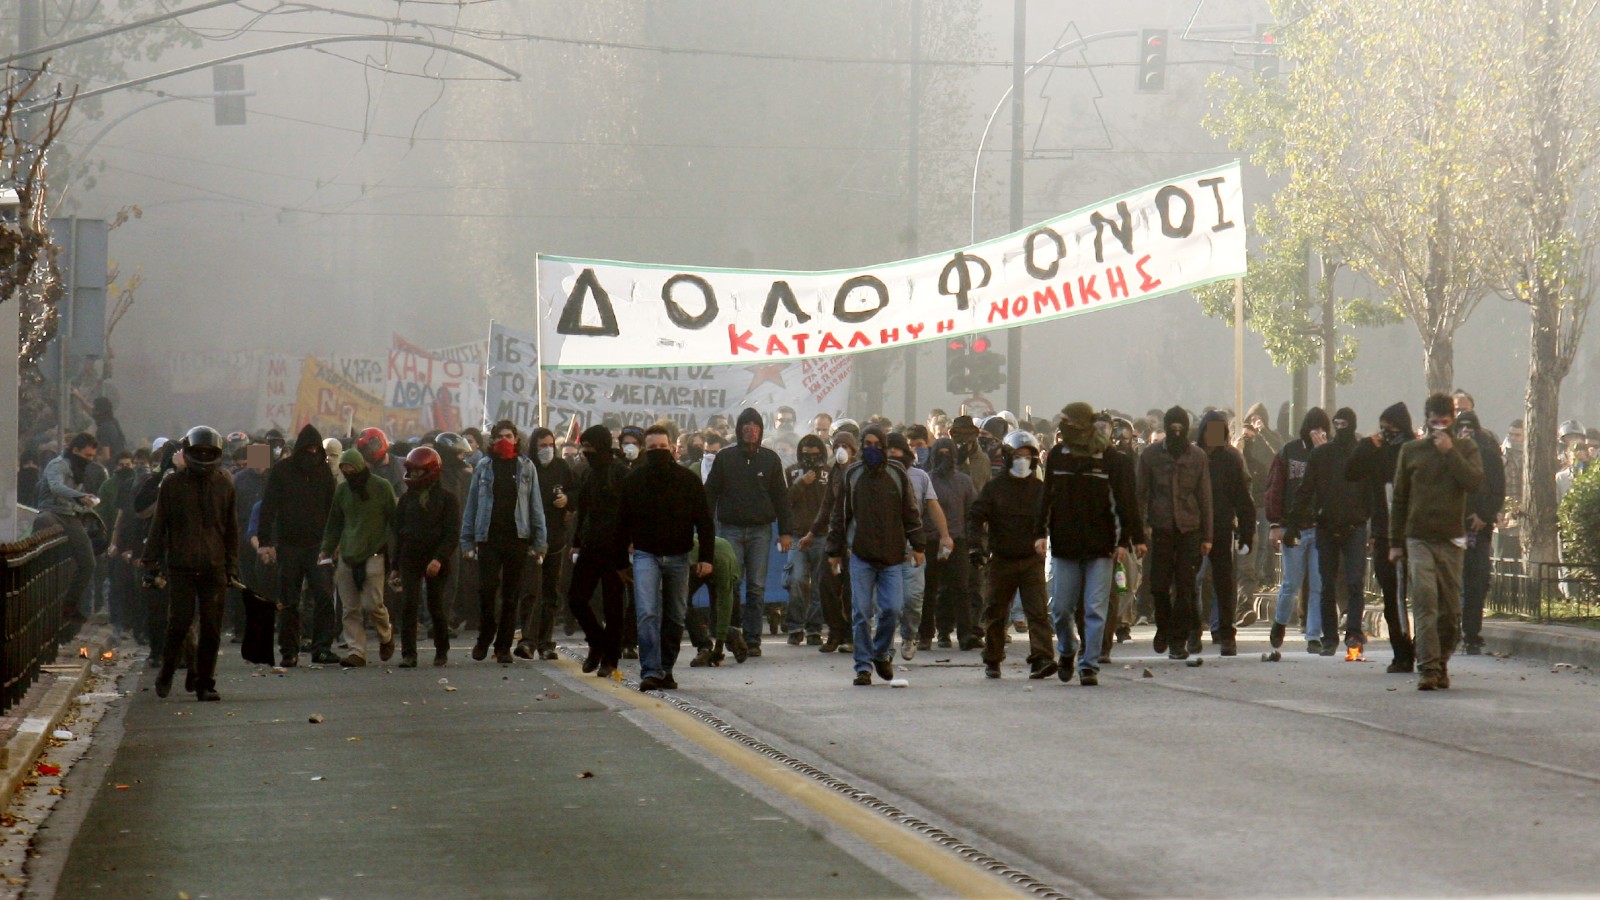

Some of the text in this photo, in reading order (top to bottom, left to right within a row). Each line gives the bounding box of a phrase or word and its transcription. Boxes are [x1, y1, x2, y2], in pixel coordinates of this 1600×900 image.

[557, 176, 1235, 337] ΔΟΛΟΦΟΝΟΙ
[729, 254, 1162, 355] ΚΑΤΑΛΗΨΗ ΝΟΜΙΚΗΣ
[495, 334, 521, 364] 16
[497, 371, 525, 393] ΤΟ
[611, 384, 727, 408] ΜΕΓΑΛΩΝΕΙ
